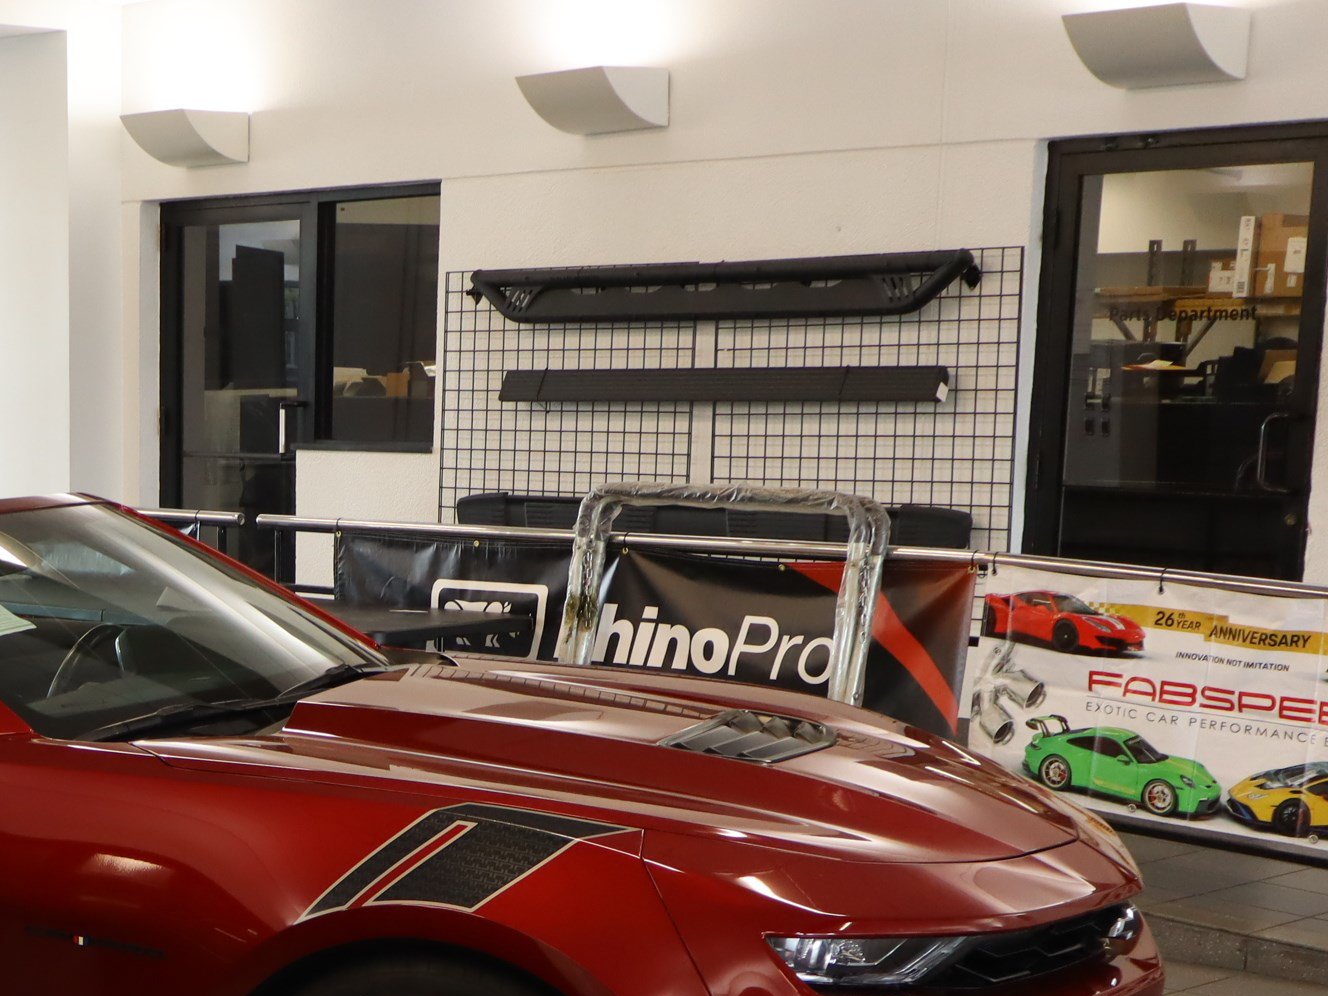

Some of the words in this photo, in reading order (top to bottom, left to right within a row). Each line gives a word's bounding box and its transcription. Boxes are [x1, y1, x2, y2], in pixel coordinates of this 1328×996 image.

[1109, 308, 1151, 321] Parts
[1157, 305, 1258, 322] Department
[553, 603, 834, 685] hinoPro
[1176, 619, 1201, 631] YEAR
[1209, 625, 1311, 649] ANNIVERSARY
[1176, 651, 1225, 665] INNOVATION
[1226, 658, 1242, 668] NOT
[1243, 661, 1290, 672] IMITATION
[1088, 670, 1328, 727] FABSPE
[1085, 701, 1138, 720] EXOTIC
[1146, 711, 1179, 726] CAR
[1188, 717, 1317, 745] PERFORMANCE
